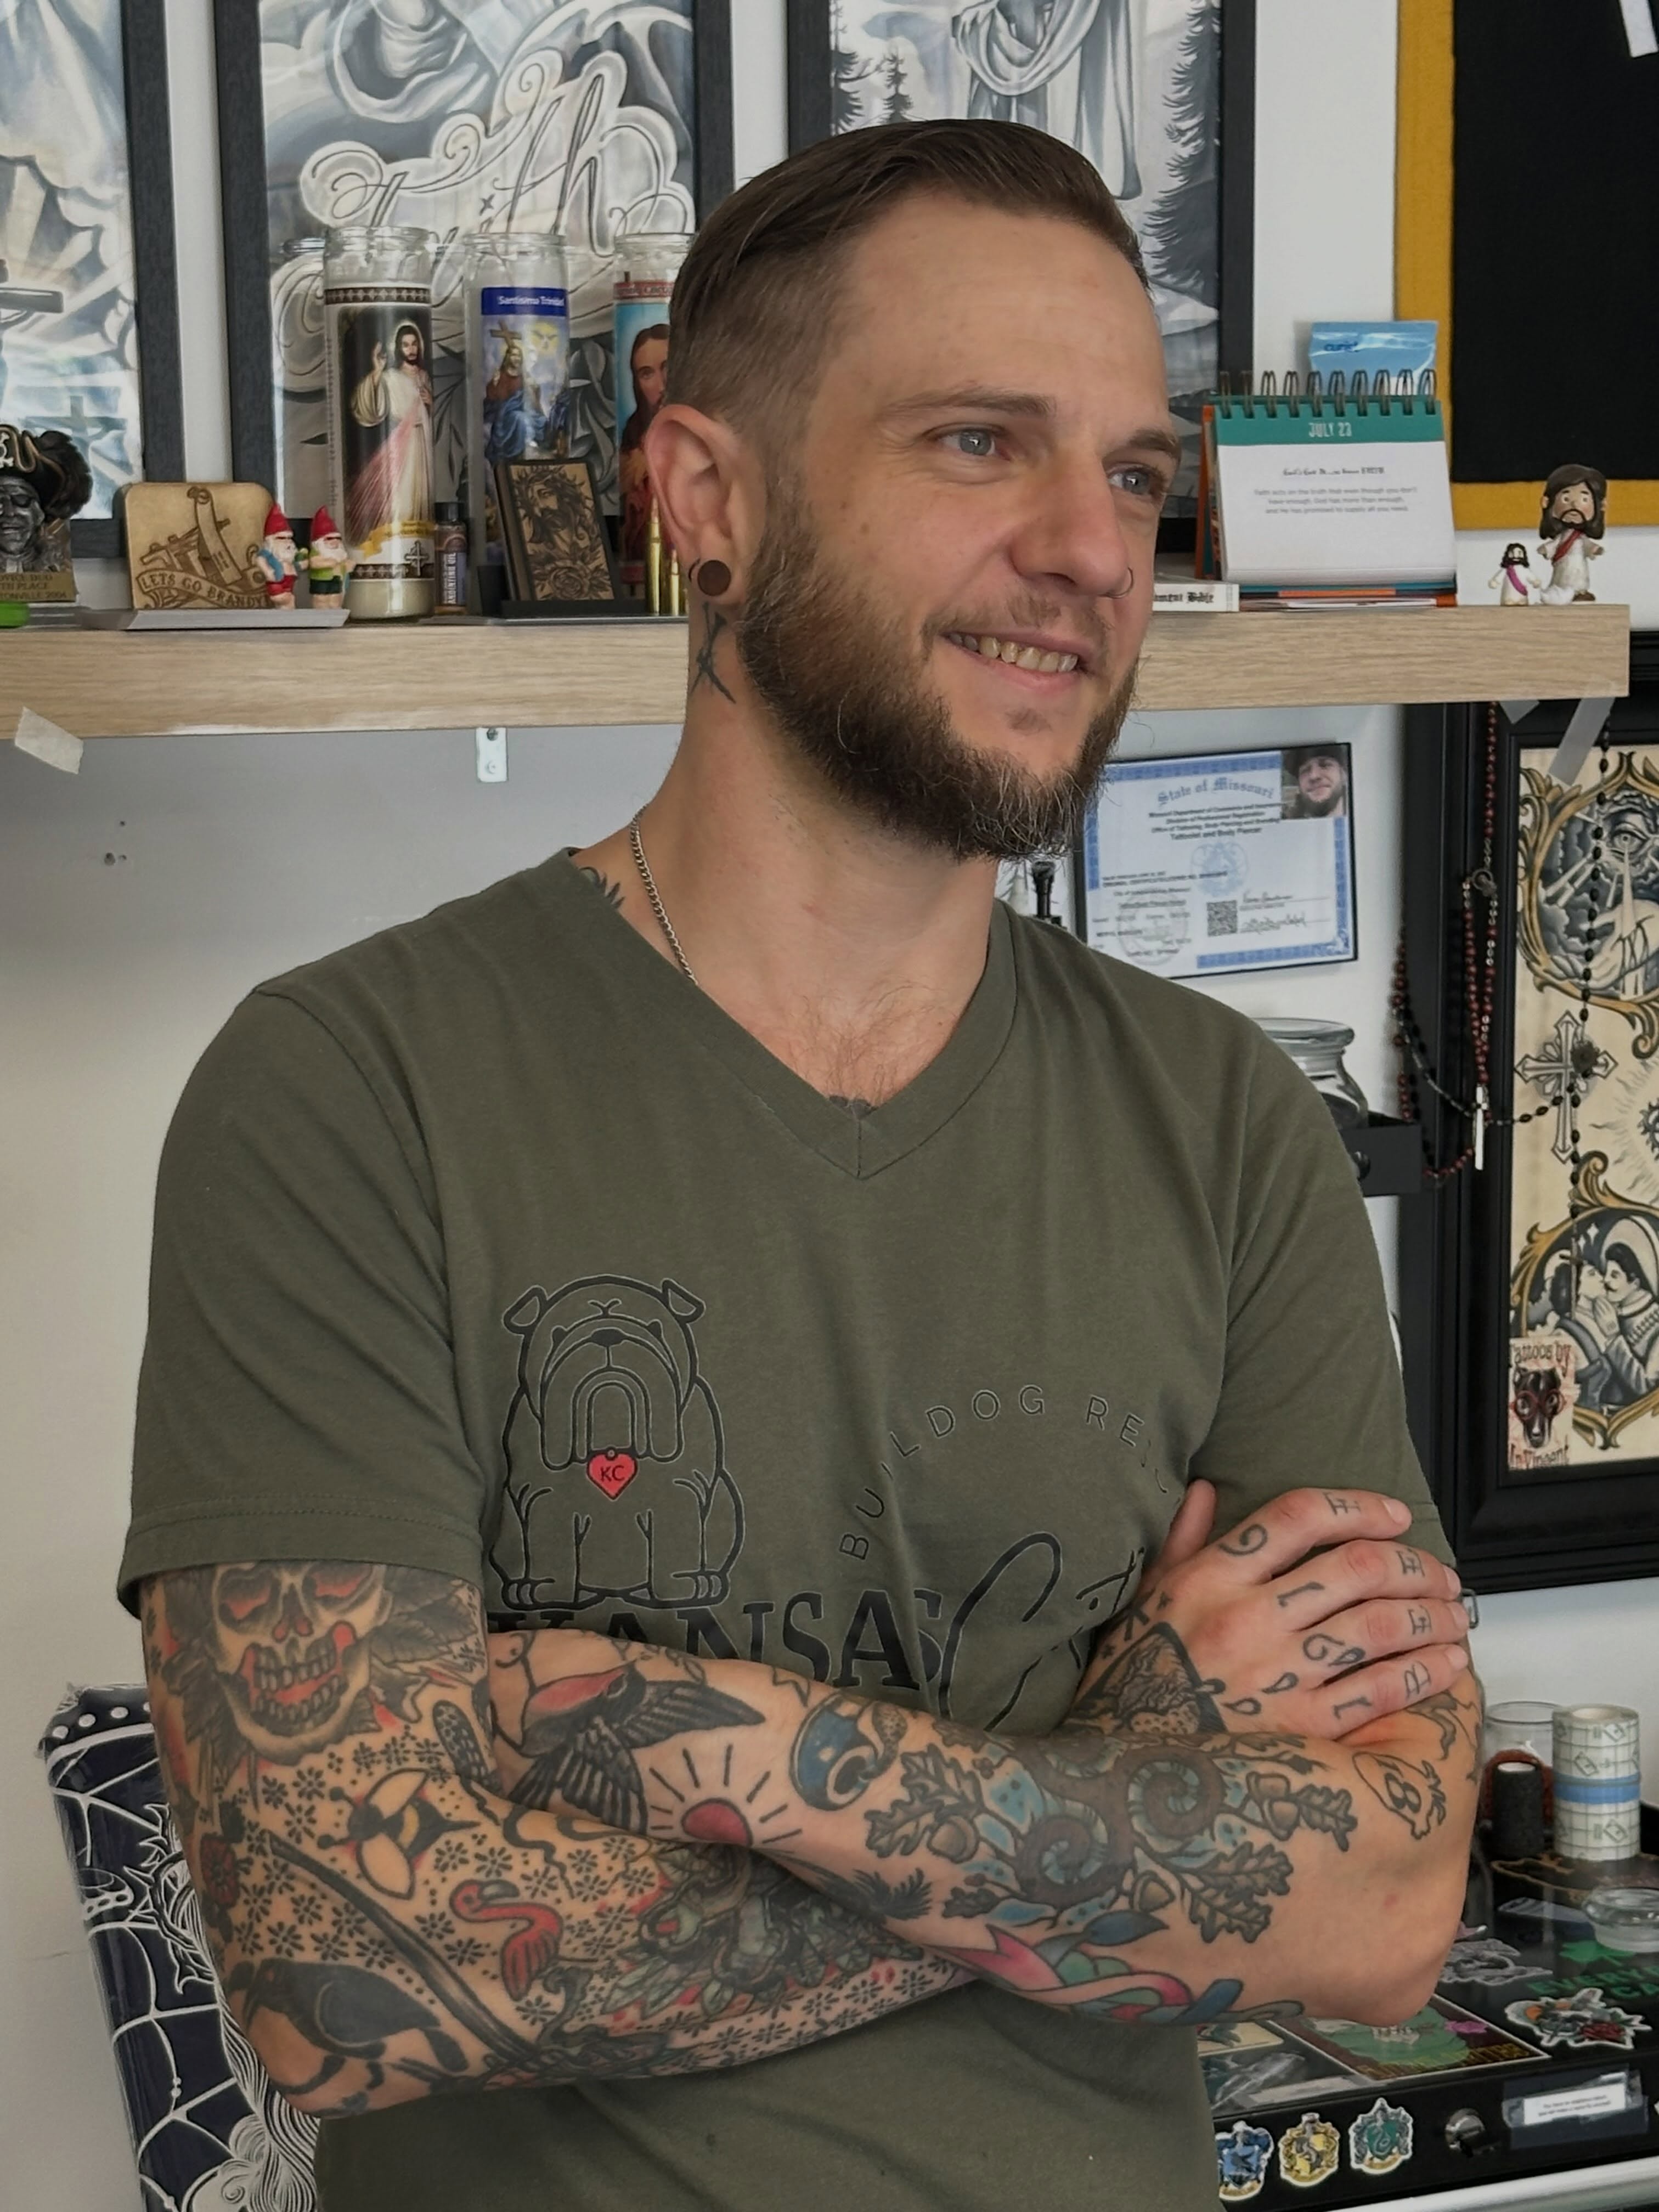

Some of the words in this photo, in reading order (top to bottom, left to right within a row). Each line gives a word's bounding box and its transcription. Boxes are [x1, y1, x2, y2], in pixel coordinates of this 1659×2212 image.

[1308, 422, 1335, 437] JULY
[1338, 422, 1352, 437] 23
[182, 578, 202, 592] GO
[1158, 786, 1191, 806] State
[1195, 779, 1208, 793] of
[1211, 777, 1274, 799] Missouri
[600, 1464, 625, 1483] KC
